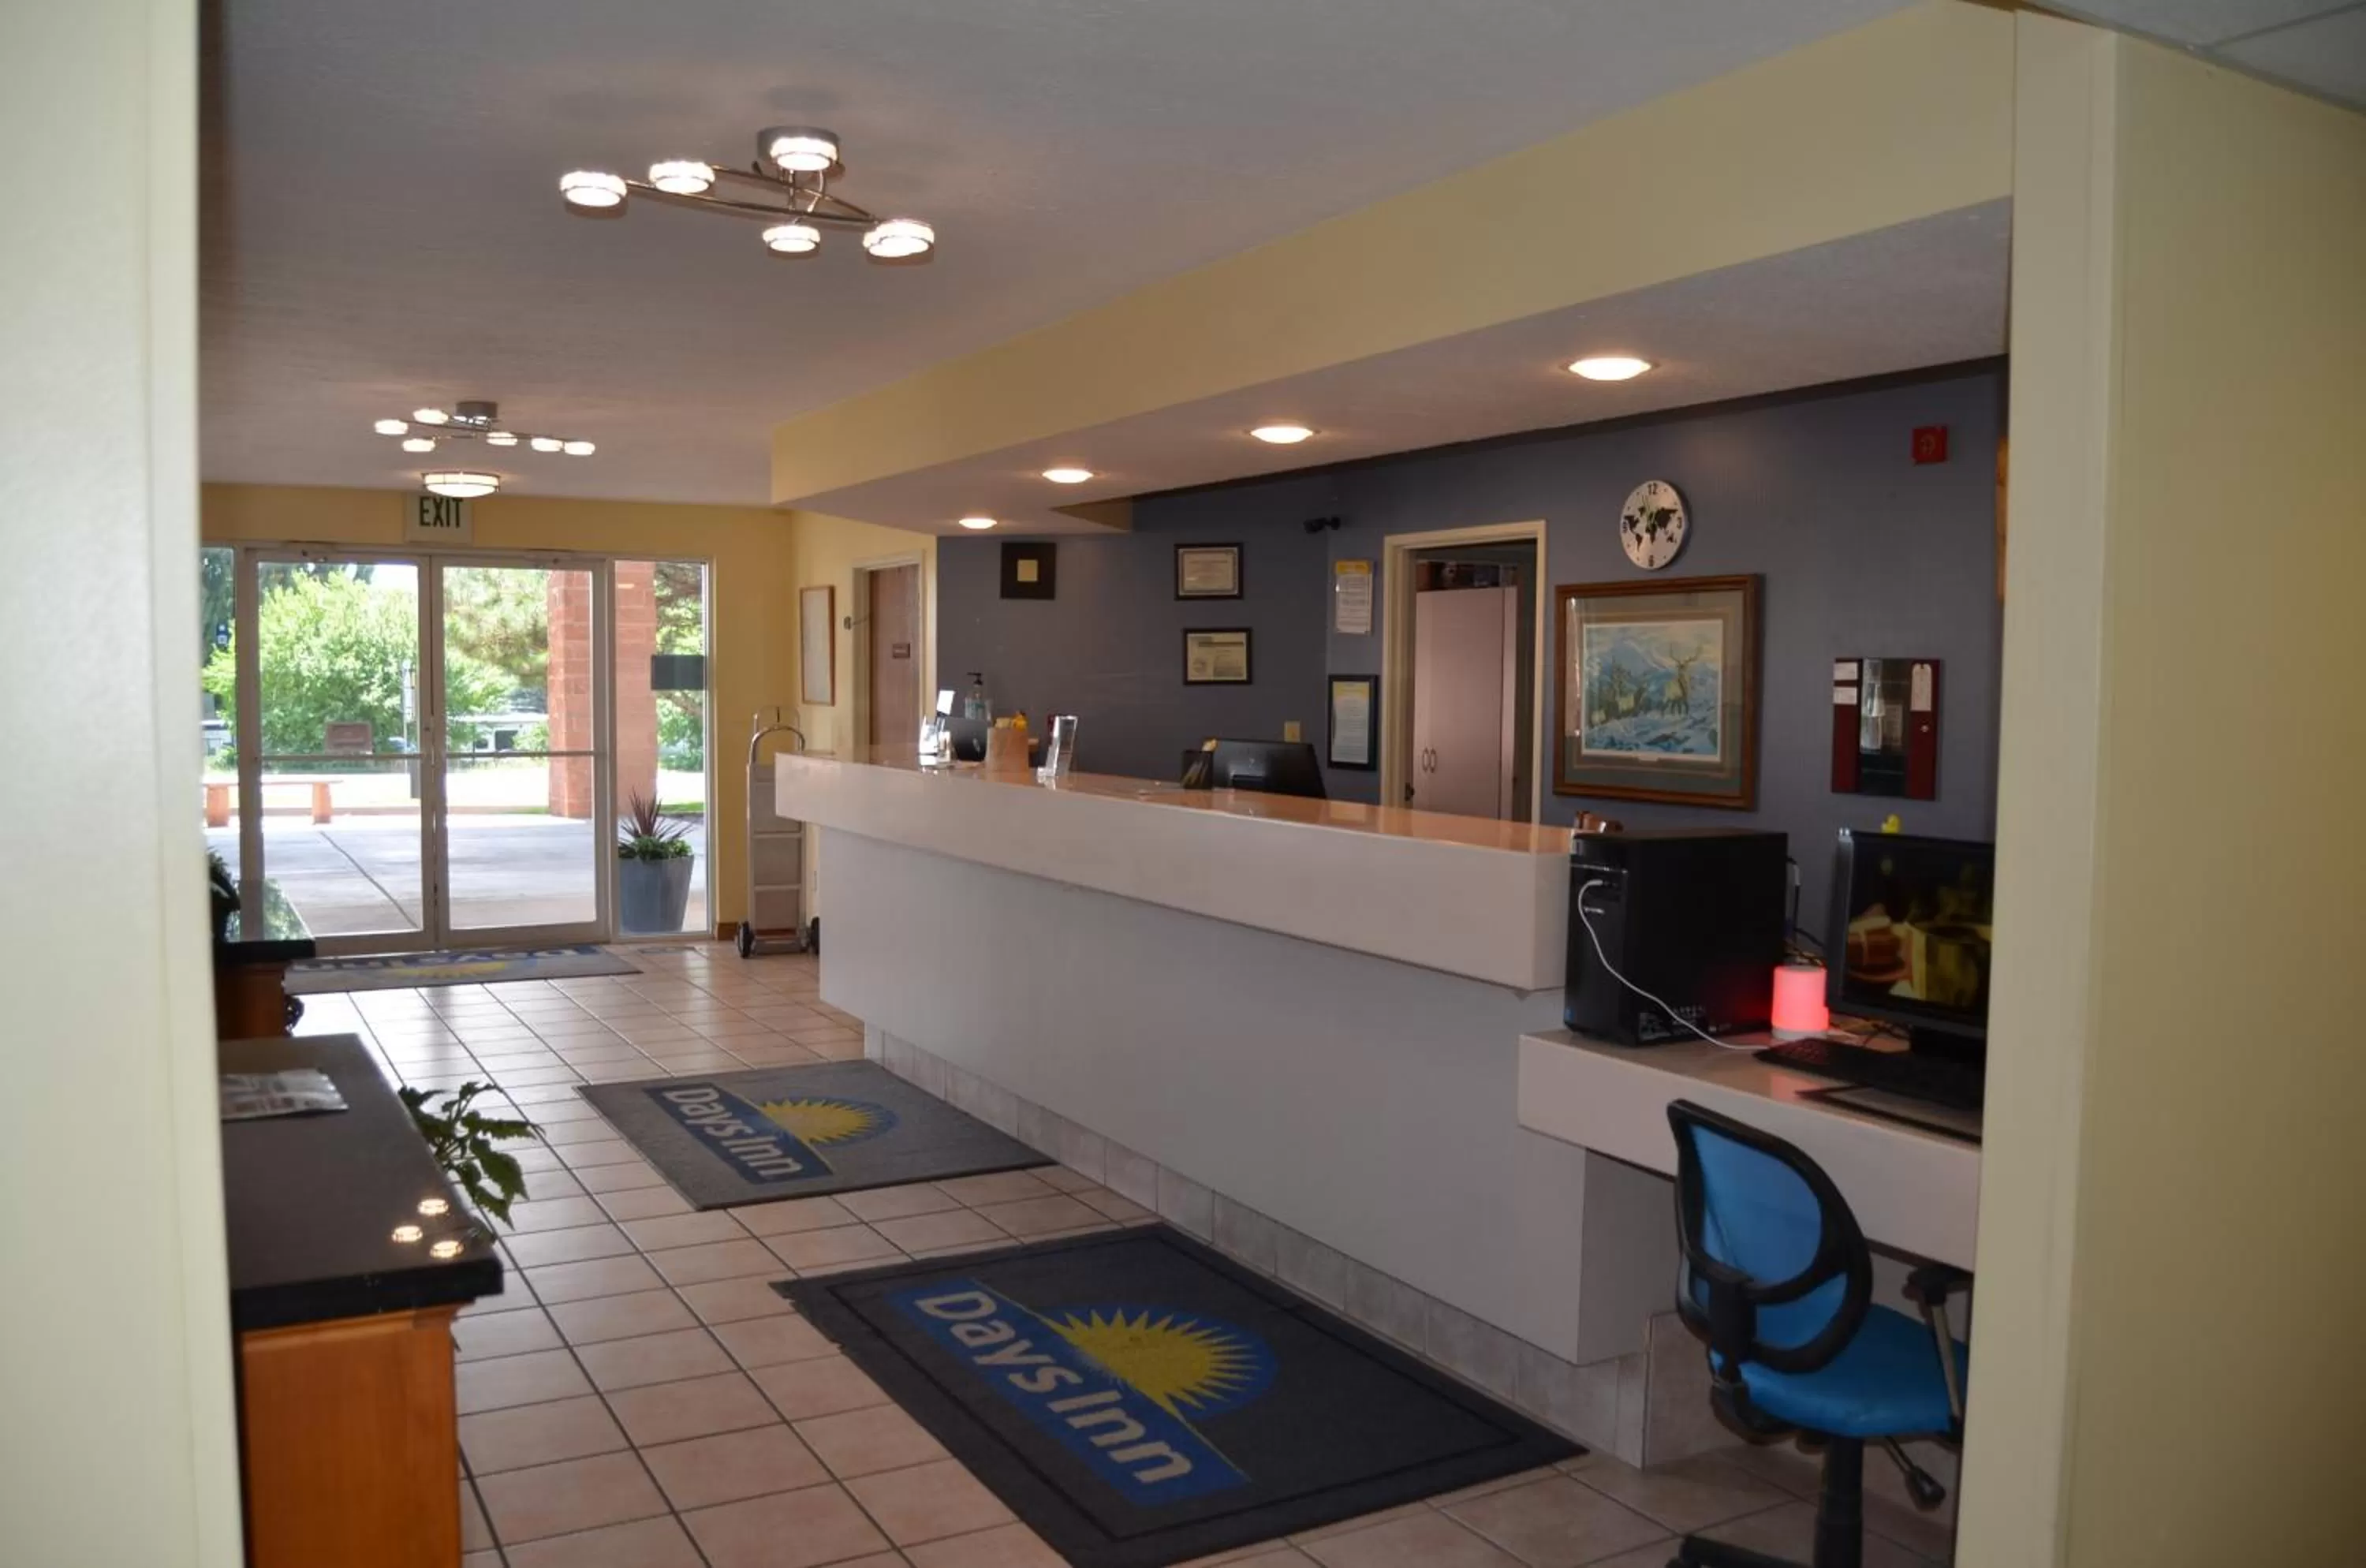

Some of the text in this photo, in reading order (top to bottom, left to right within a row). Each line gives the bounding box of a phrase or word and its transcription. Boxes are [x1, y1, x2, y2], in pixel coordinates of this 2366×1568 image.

[420, 496, 464, 528] EXIT
[661, 1087, 803, 1177] Days Inn
[913, 1290, 1193, 1484] Days Inn
